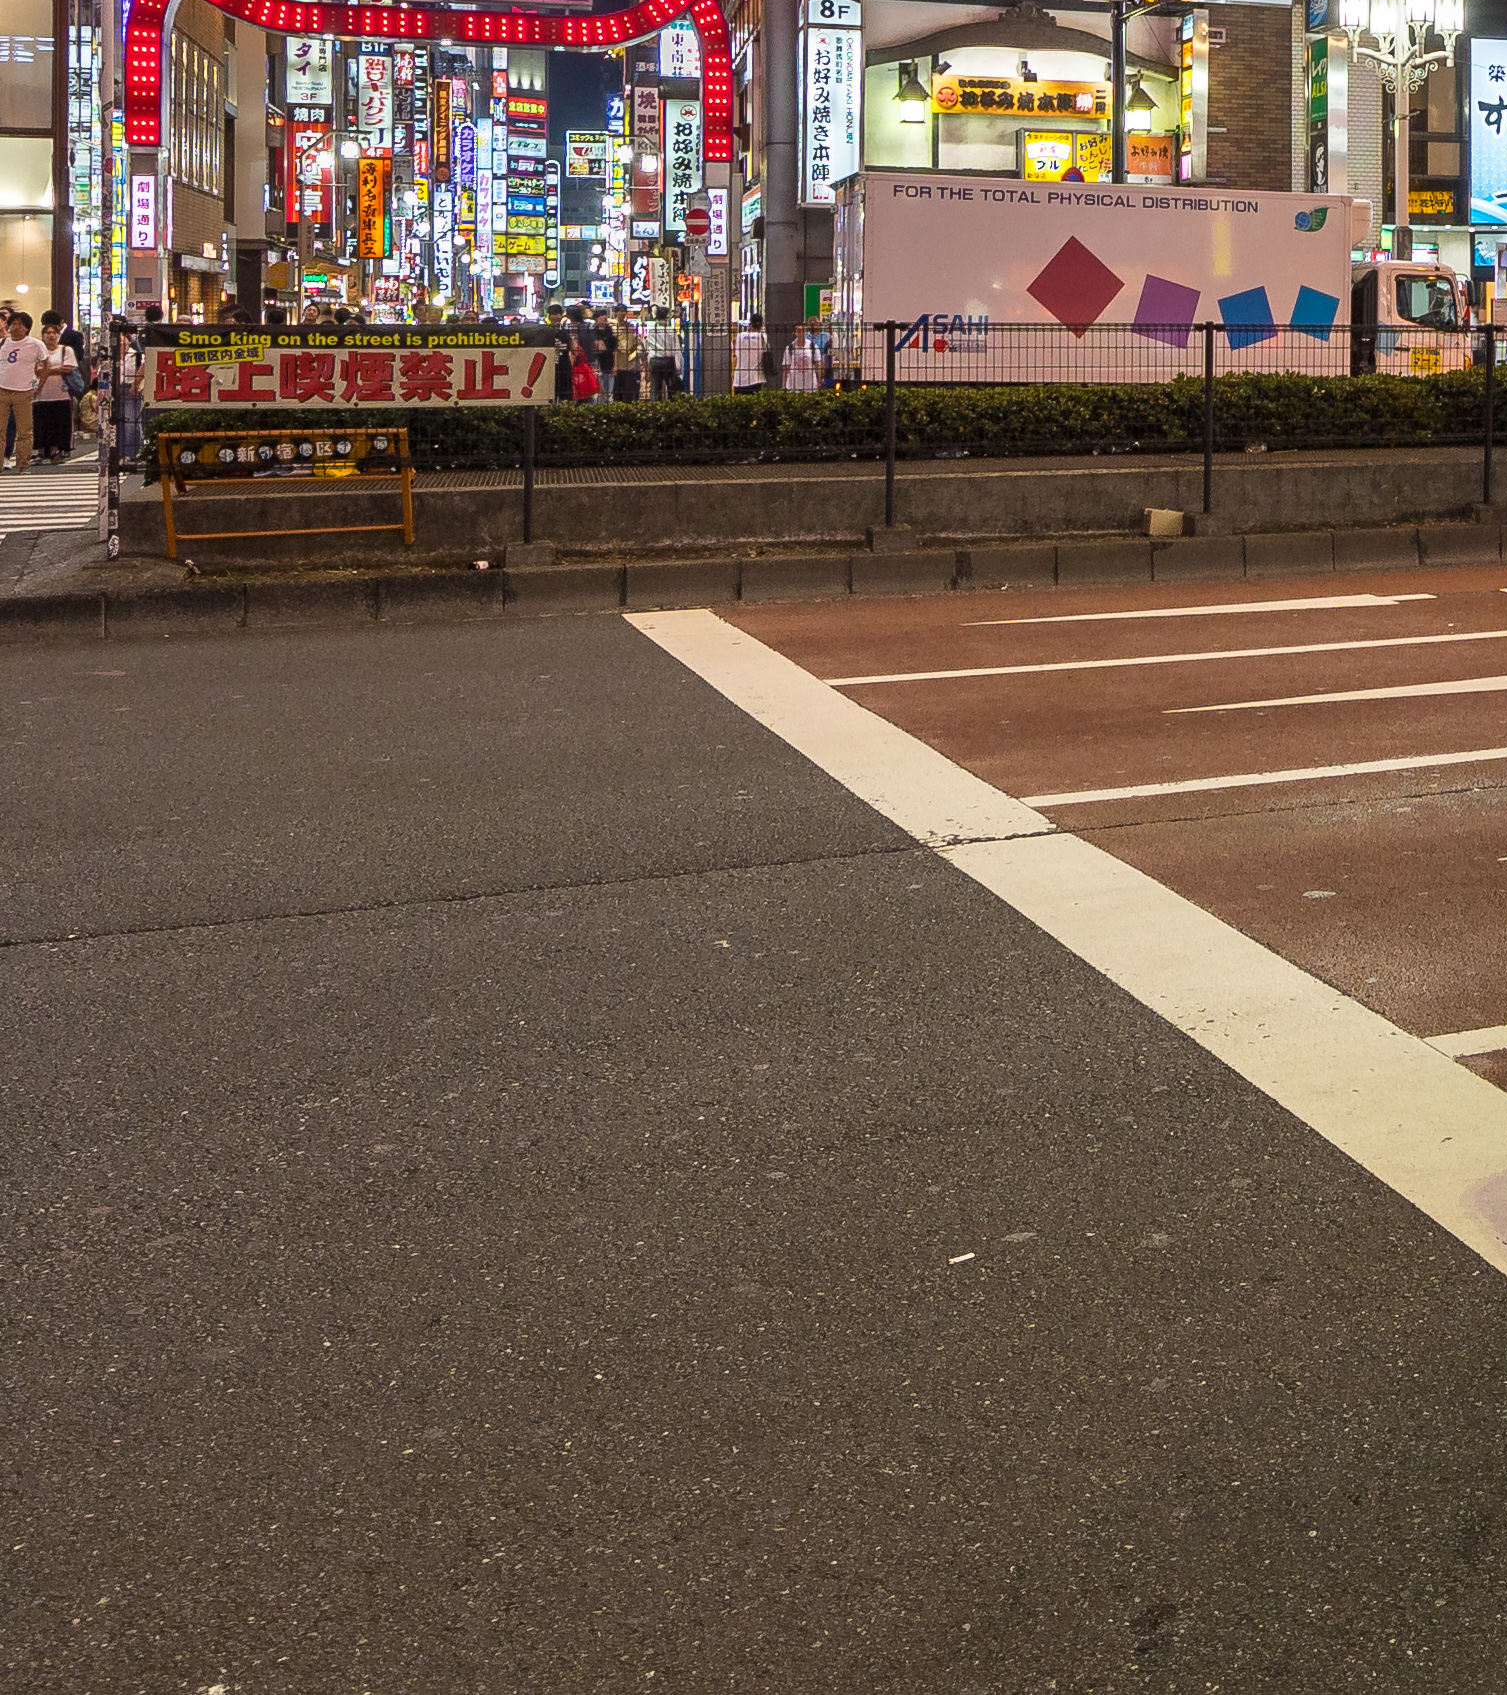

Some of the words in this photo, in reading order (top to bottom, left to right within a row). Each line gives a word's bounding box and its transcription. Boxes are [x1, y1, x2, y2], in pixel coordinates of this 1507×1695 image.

[820, 0, 850, 18] 8F
[294, 43, 312, 76] タイ
[294, 108, 325, 122] 焼肉
[812, 48, 831, 181] お好み焼き本陣
[137, 181, 150, 242] 劇場通り
[893, 185, 932, 199] FOR
[937, 186, 974, 202] THE
[980, 188, 1041, 205] TOTAL
[1047, 191, 1137, 209] PHYSICAL
[1142, 195, 1259, 214] DISTRIBUTION
[712, 195, 723, 250] 劇場通り
[277, 335, 301, 346] on
[308, 331, 338, 346] the
[344, 332, 401, 346] street
[406, 331, 423, 346] is
[428, 331, 525, 346] prohibited.
[894, 313, 988, 353] ASAHI
[179, 347, 260, 364] 新宿区内全域
[154, 350, 547, 404] 路上喫煙禁止!
